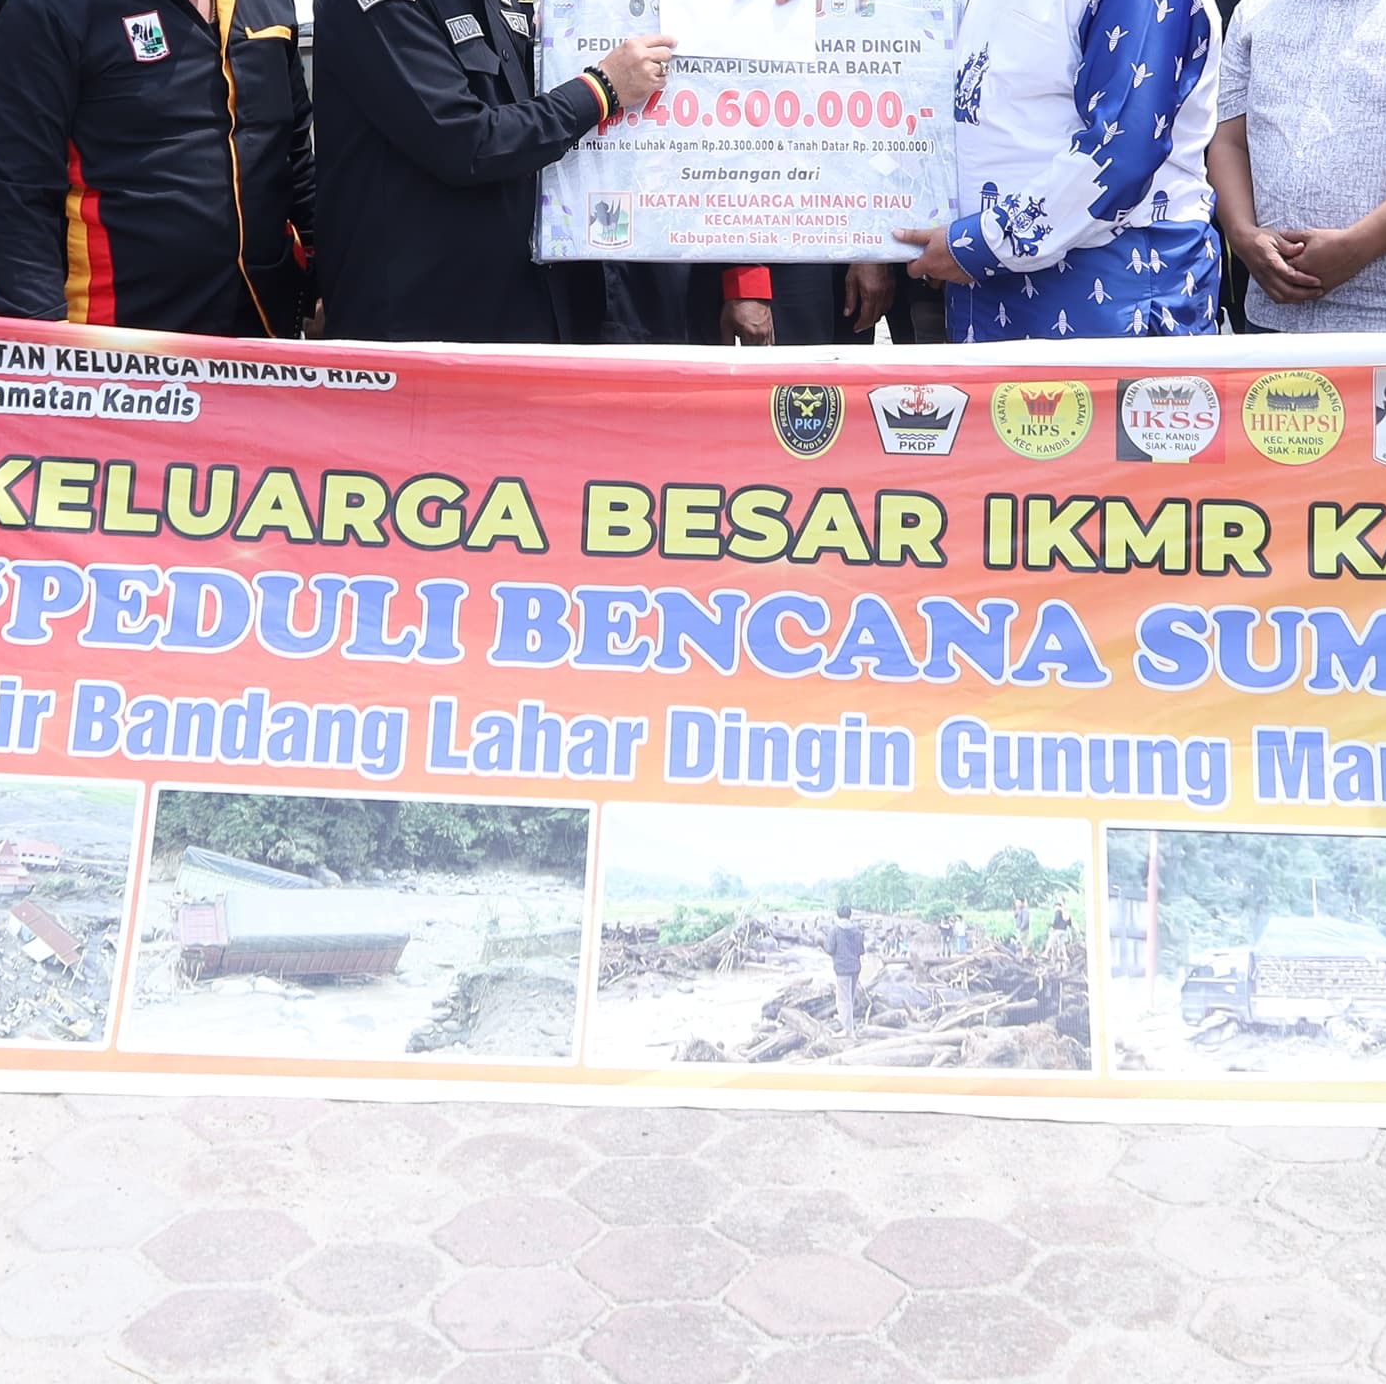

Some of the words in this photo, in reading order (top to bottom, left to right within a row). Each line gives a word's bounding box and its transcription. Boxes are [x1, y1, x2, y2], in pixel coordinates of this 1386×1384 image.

[862, 39, 922, 54] DINGIN
[676, 59, 742, 74] MARAPI
[748, 59, 840, 75] SUMATERA
[846, 61, 902, 75] BARAT
[598, 89, 934, 136] p.40.600.000,-
[619, 139, 632, 151] ke
[634, 139, 666, 151] Luhak
[669, 140, 698, 154] Agam
[702, 140, 774, 154] Rp.20.300.000
[777, 140, 784, 151] &
[788, 140, 818, 151] Tanah
[821, 140, 849, 152] Datar
[853, 140, 869, 154] Rp.
[681, 166, 781, 183] Sumbangan
[787, 166, 821, 181] dari
[639, 194, 700, 208] IKATAN
[705, 194, 794, 209] KELUARGA
[800, 195, 867, 209] MINANG
[873, 195, 913, 209] RIAU
[704, 214, 791, 227] KECAMATAN
[796, 215, 848, 227] KANDIS
[669, 232, 745, 248] Kabupaten
[748, 232, 778, 245] Siak
[791, 233, 848, 246] Provinsi
[852, 233, 883, 245] Riau
[55, 348, 200, 378] KELUARGA
[208, 360, 318, 383] MINANG
[102, 386, 195, 416] Kandis
[1245, 373, 1282, 411] HIMPUNAN
[1315, 376, 1342, 413] PADANG
[997, 393, 1008, 425] IKATAN
[1073, 389, 1087, 426] SELATAN
[794, 418, 822, 431] PKP
[1129, 409, 1215, 430] IKSS
[1250, 413, 1339, 433] HIFAPSI
[1021, 423, 1060, 437] IKPS
[1142, 432, 1164, 441] KEC.
[1166, 433, 1200, 441] KANDIS
[791, 438, 823, 450] KANDIS
[899, 441, 936, 451] PKDP
[1036, 437, 1071, 454] KANDIS
[1145, 442, 1167, 450] SIAK
[1174, 443, 1197, 451] RIAU
[1263, 436, 1286, 445] KEC.
[1288, 436, 1324, 446] KANDIS
[1267, 446, 1289, 455] SIAK
[1297, 446, 1321, 456] RIAU
[582, 482, 947, 568] BESAR
[984, 493, 1270, 576] IKMR
[492, 586, 1109, 683] BENCANA
[73, 684, 404, 775] Bandang
[431, 701, 644, 776] Lahar
[670, 711, 910, 793] Dingin
[941, 719, 1226, 806] Gunung
